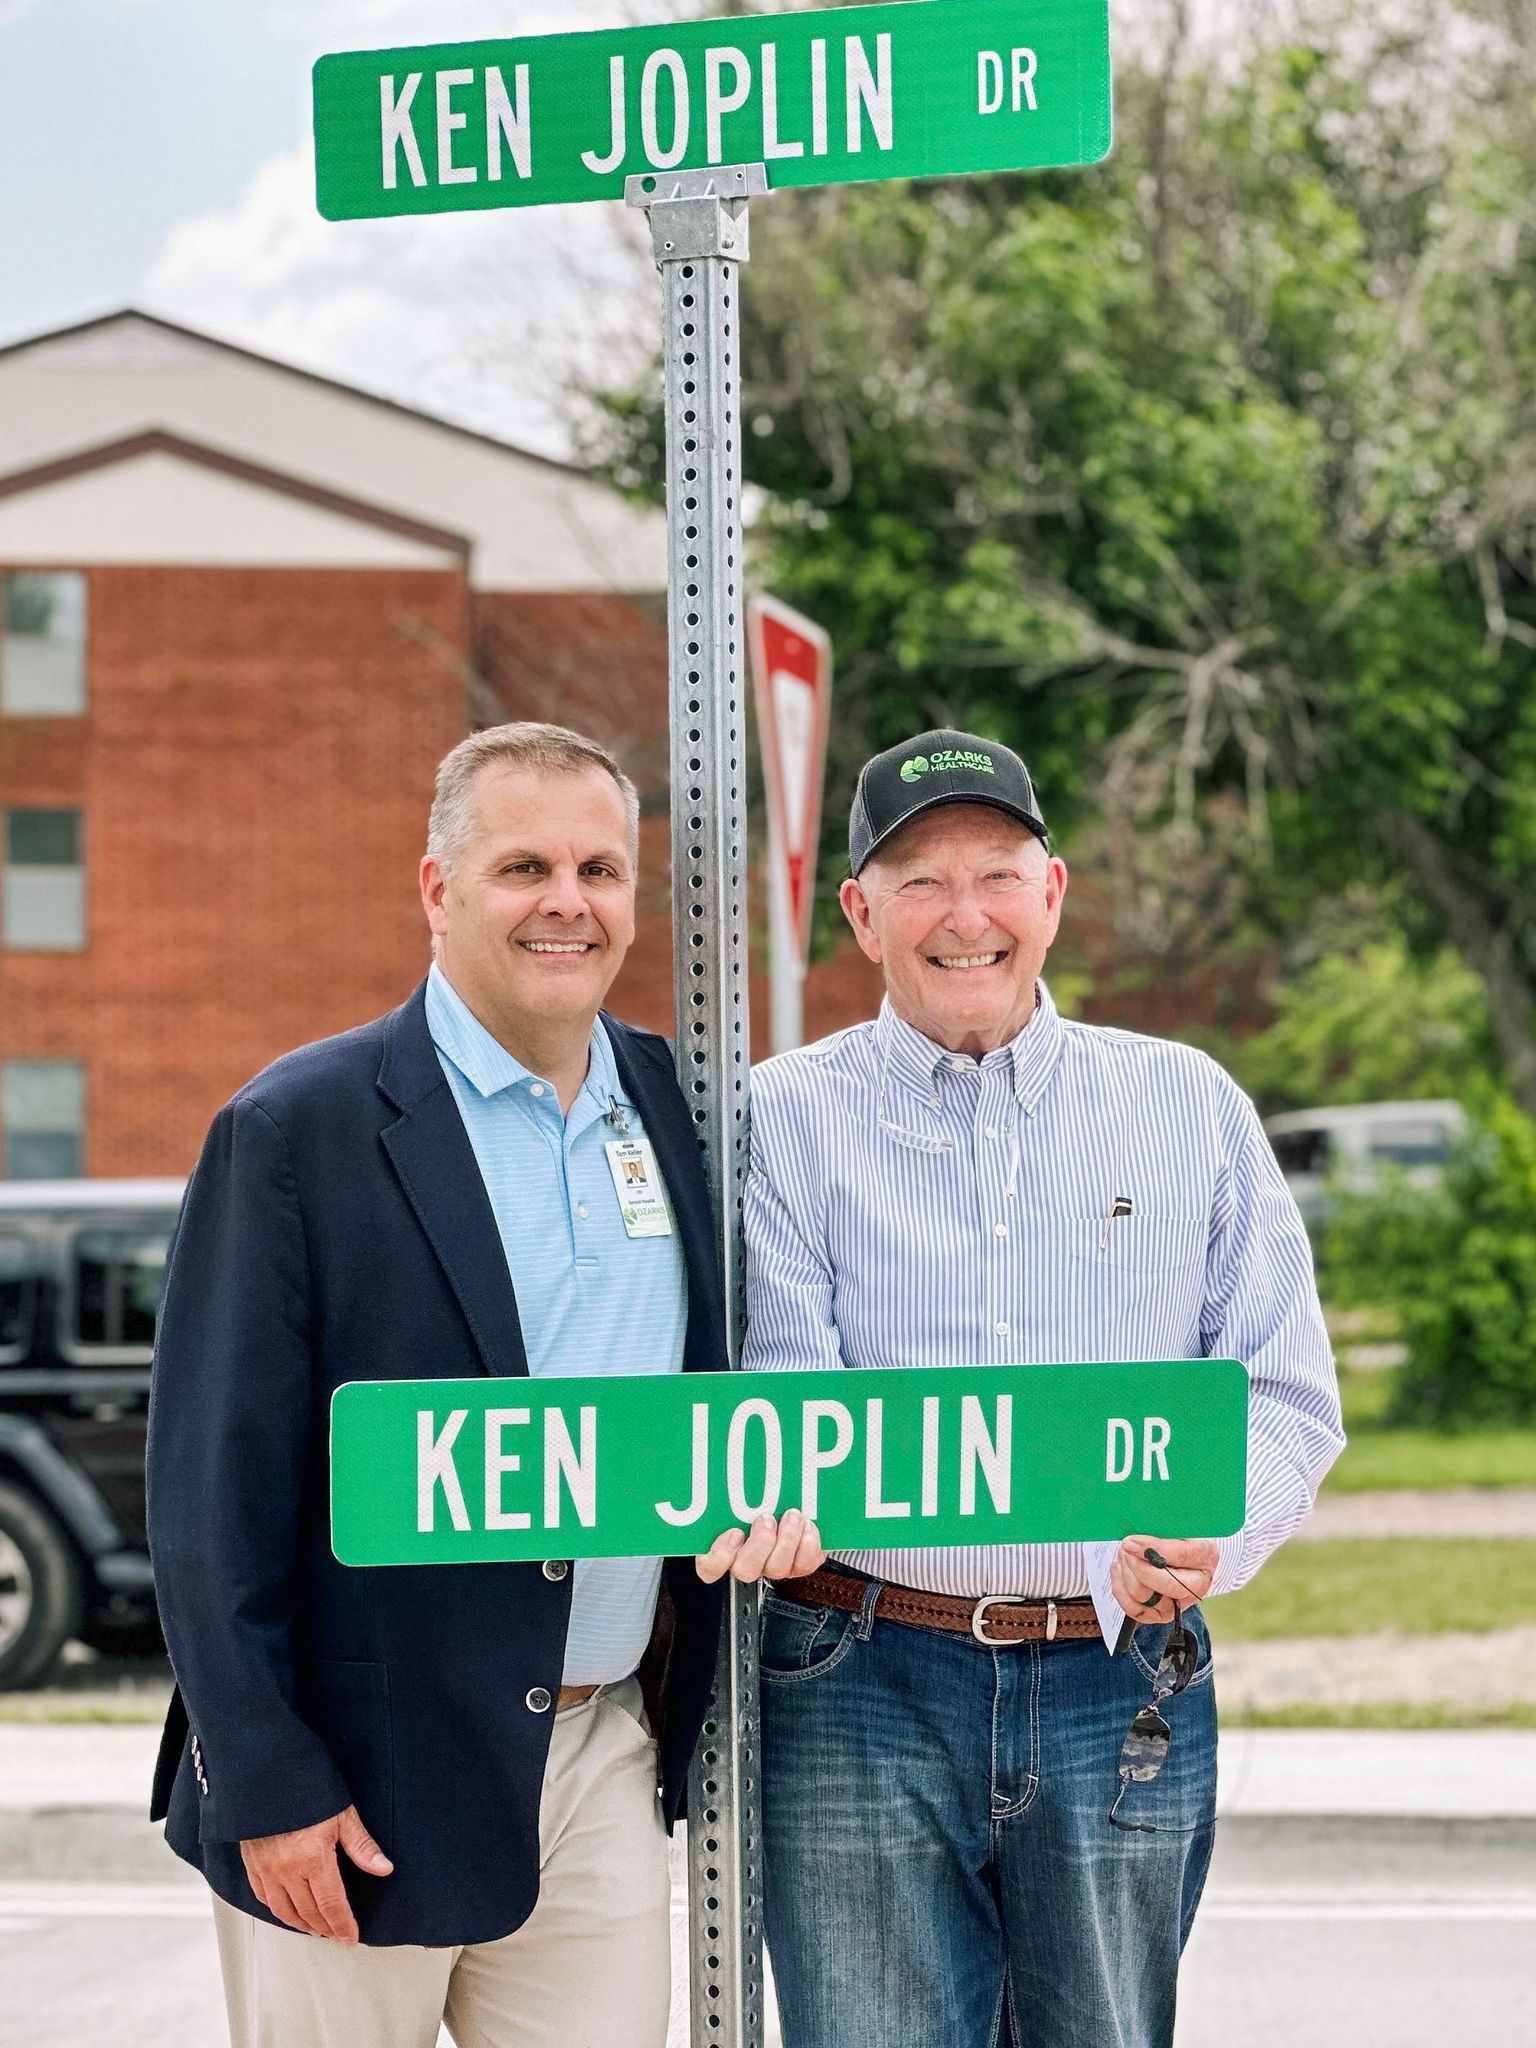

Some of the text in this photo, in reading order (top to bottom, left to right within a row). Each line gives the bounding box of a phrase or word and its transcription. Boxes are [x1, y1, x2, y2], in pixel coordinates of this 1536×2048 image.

[380, 33, 1038, 189] KEN JOPLIN DR
[930, 750, 993, 767] OZARKS
[931, 761, 995, 775] HEALTHCARE
[637, 1206, 666, 1216] OZARKS
[417, 1394, 1171, 1533] KEN JOPLIN DR
